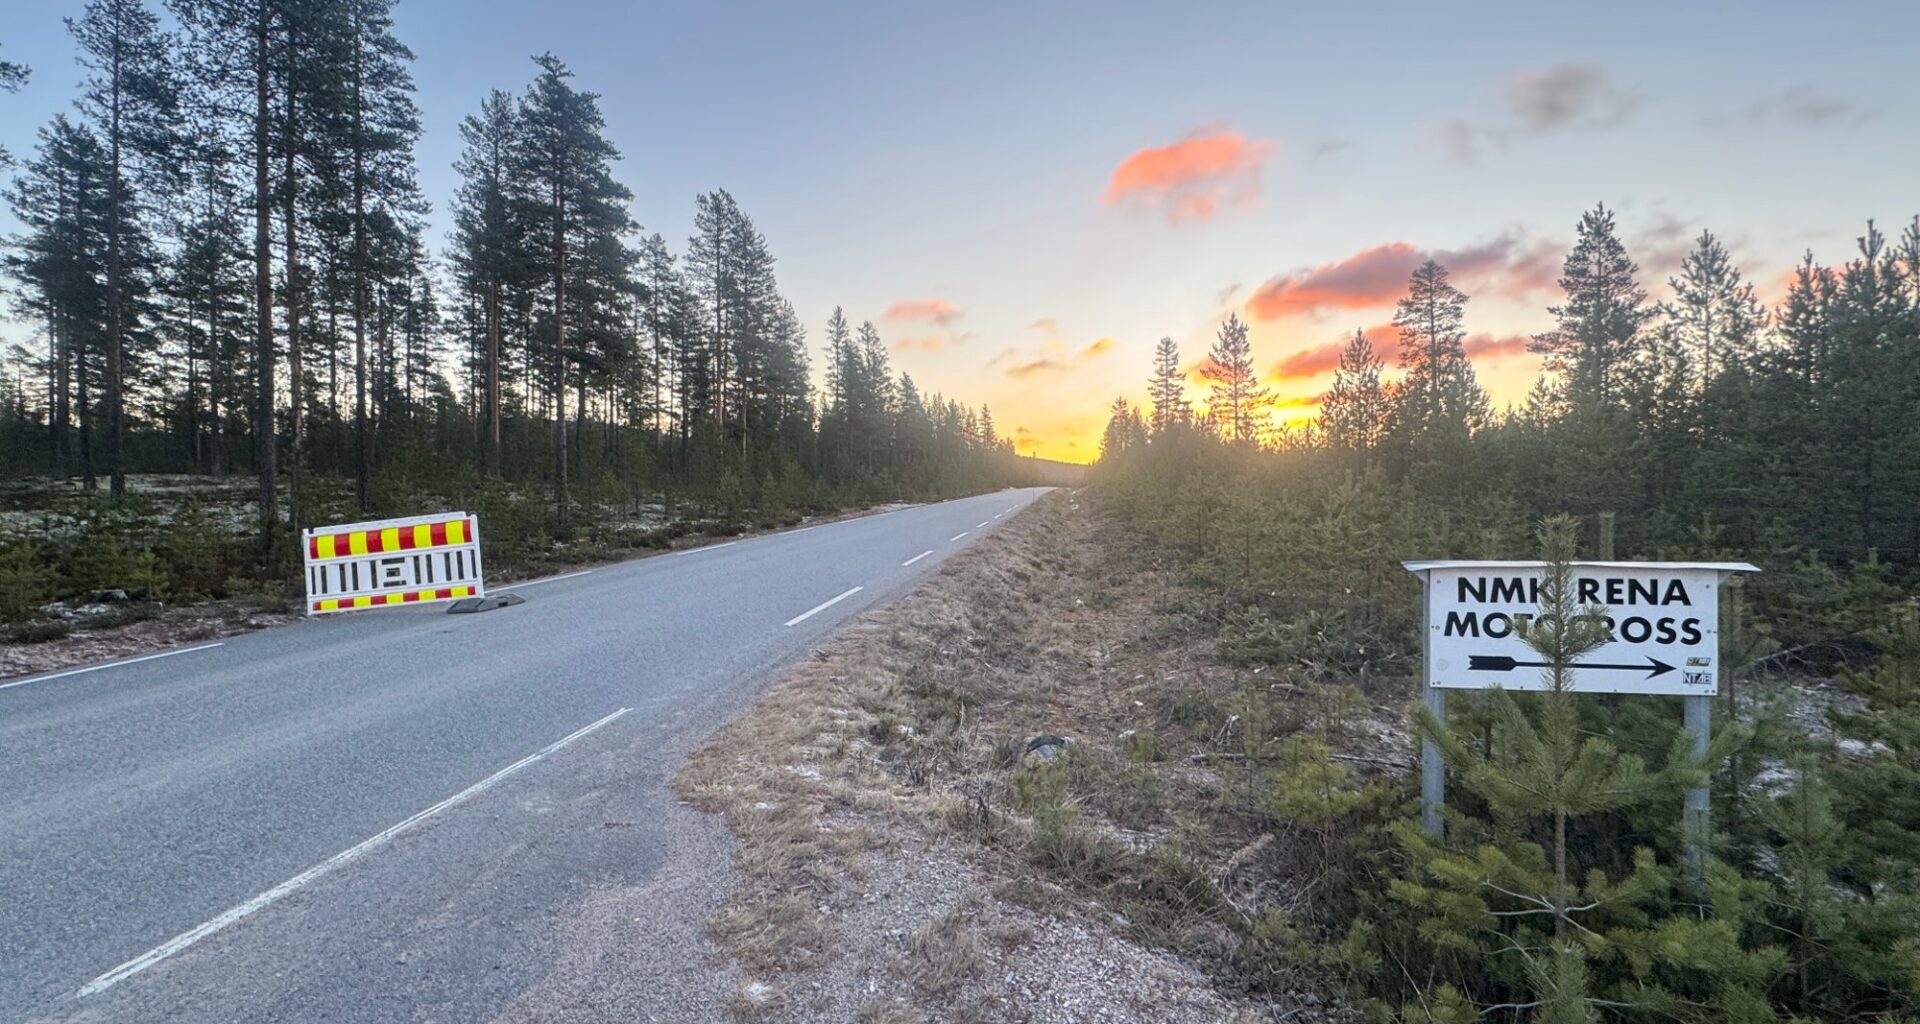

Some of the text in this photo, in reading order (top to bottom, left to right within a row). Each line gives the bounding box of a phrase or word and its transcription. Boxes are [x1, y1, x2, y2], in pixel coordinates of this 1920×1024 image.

[1457, 576, 1692, 606] NMK RENA
[1444, 611, 1702, 645] MOTROSS
